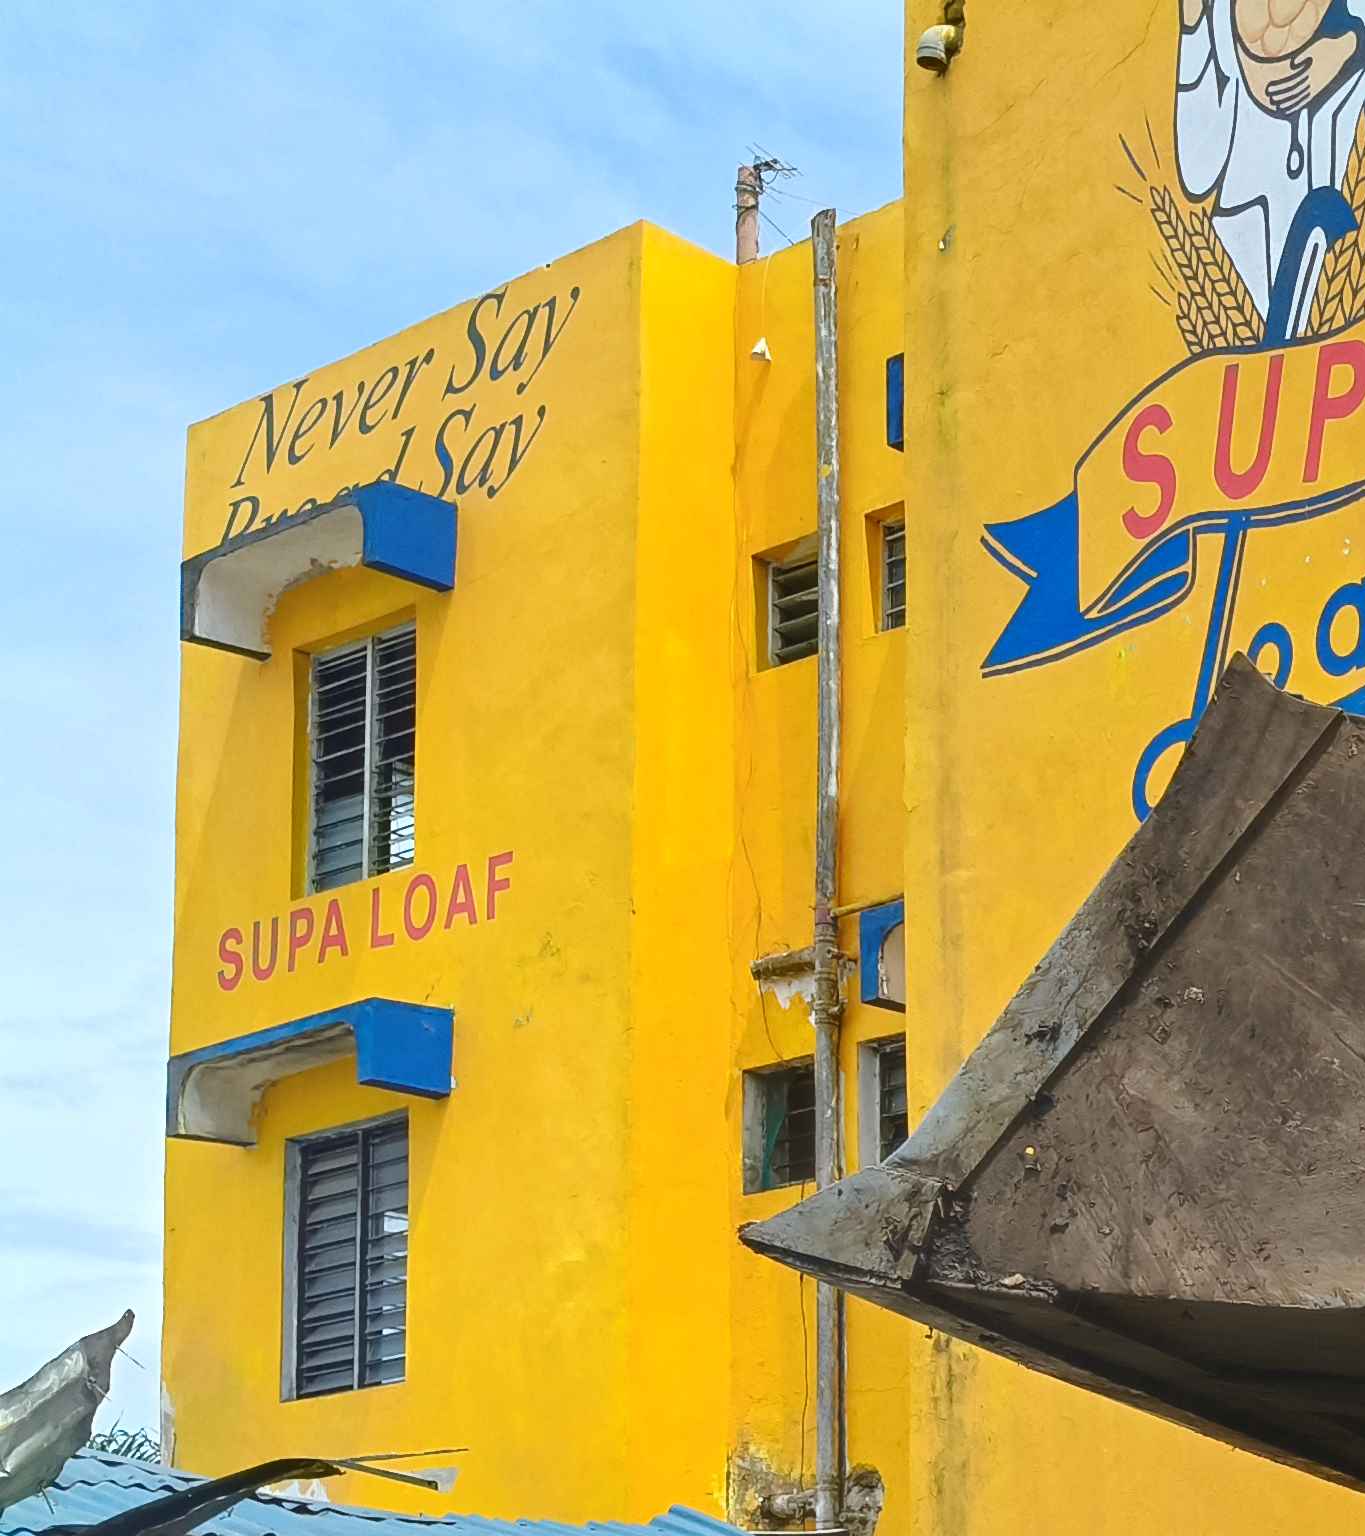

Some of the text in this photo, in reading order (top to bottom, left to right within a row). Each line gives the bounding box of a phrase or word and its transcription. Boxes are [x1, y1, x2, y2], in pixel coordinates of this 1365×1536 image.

[230, 348, 435, 489] Never
[442, 286, 581, 396] Say
[416, 403, 546, 500] Say
[217, 850, 514, 991] SUPA LOAF
